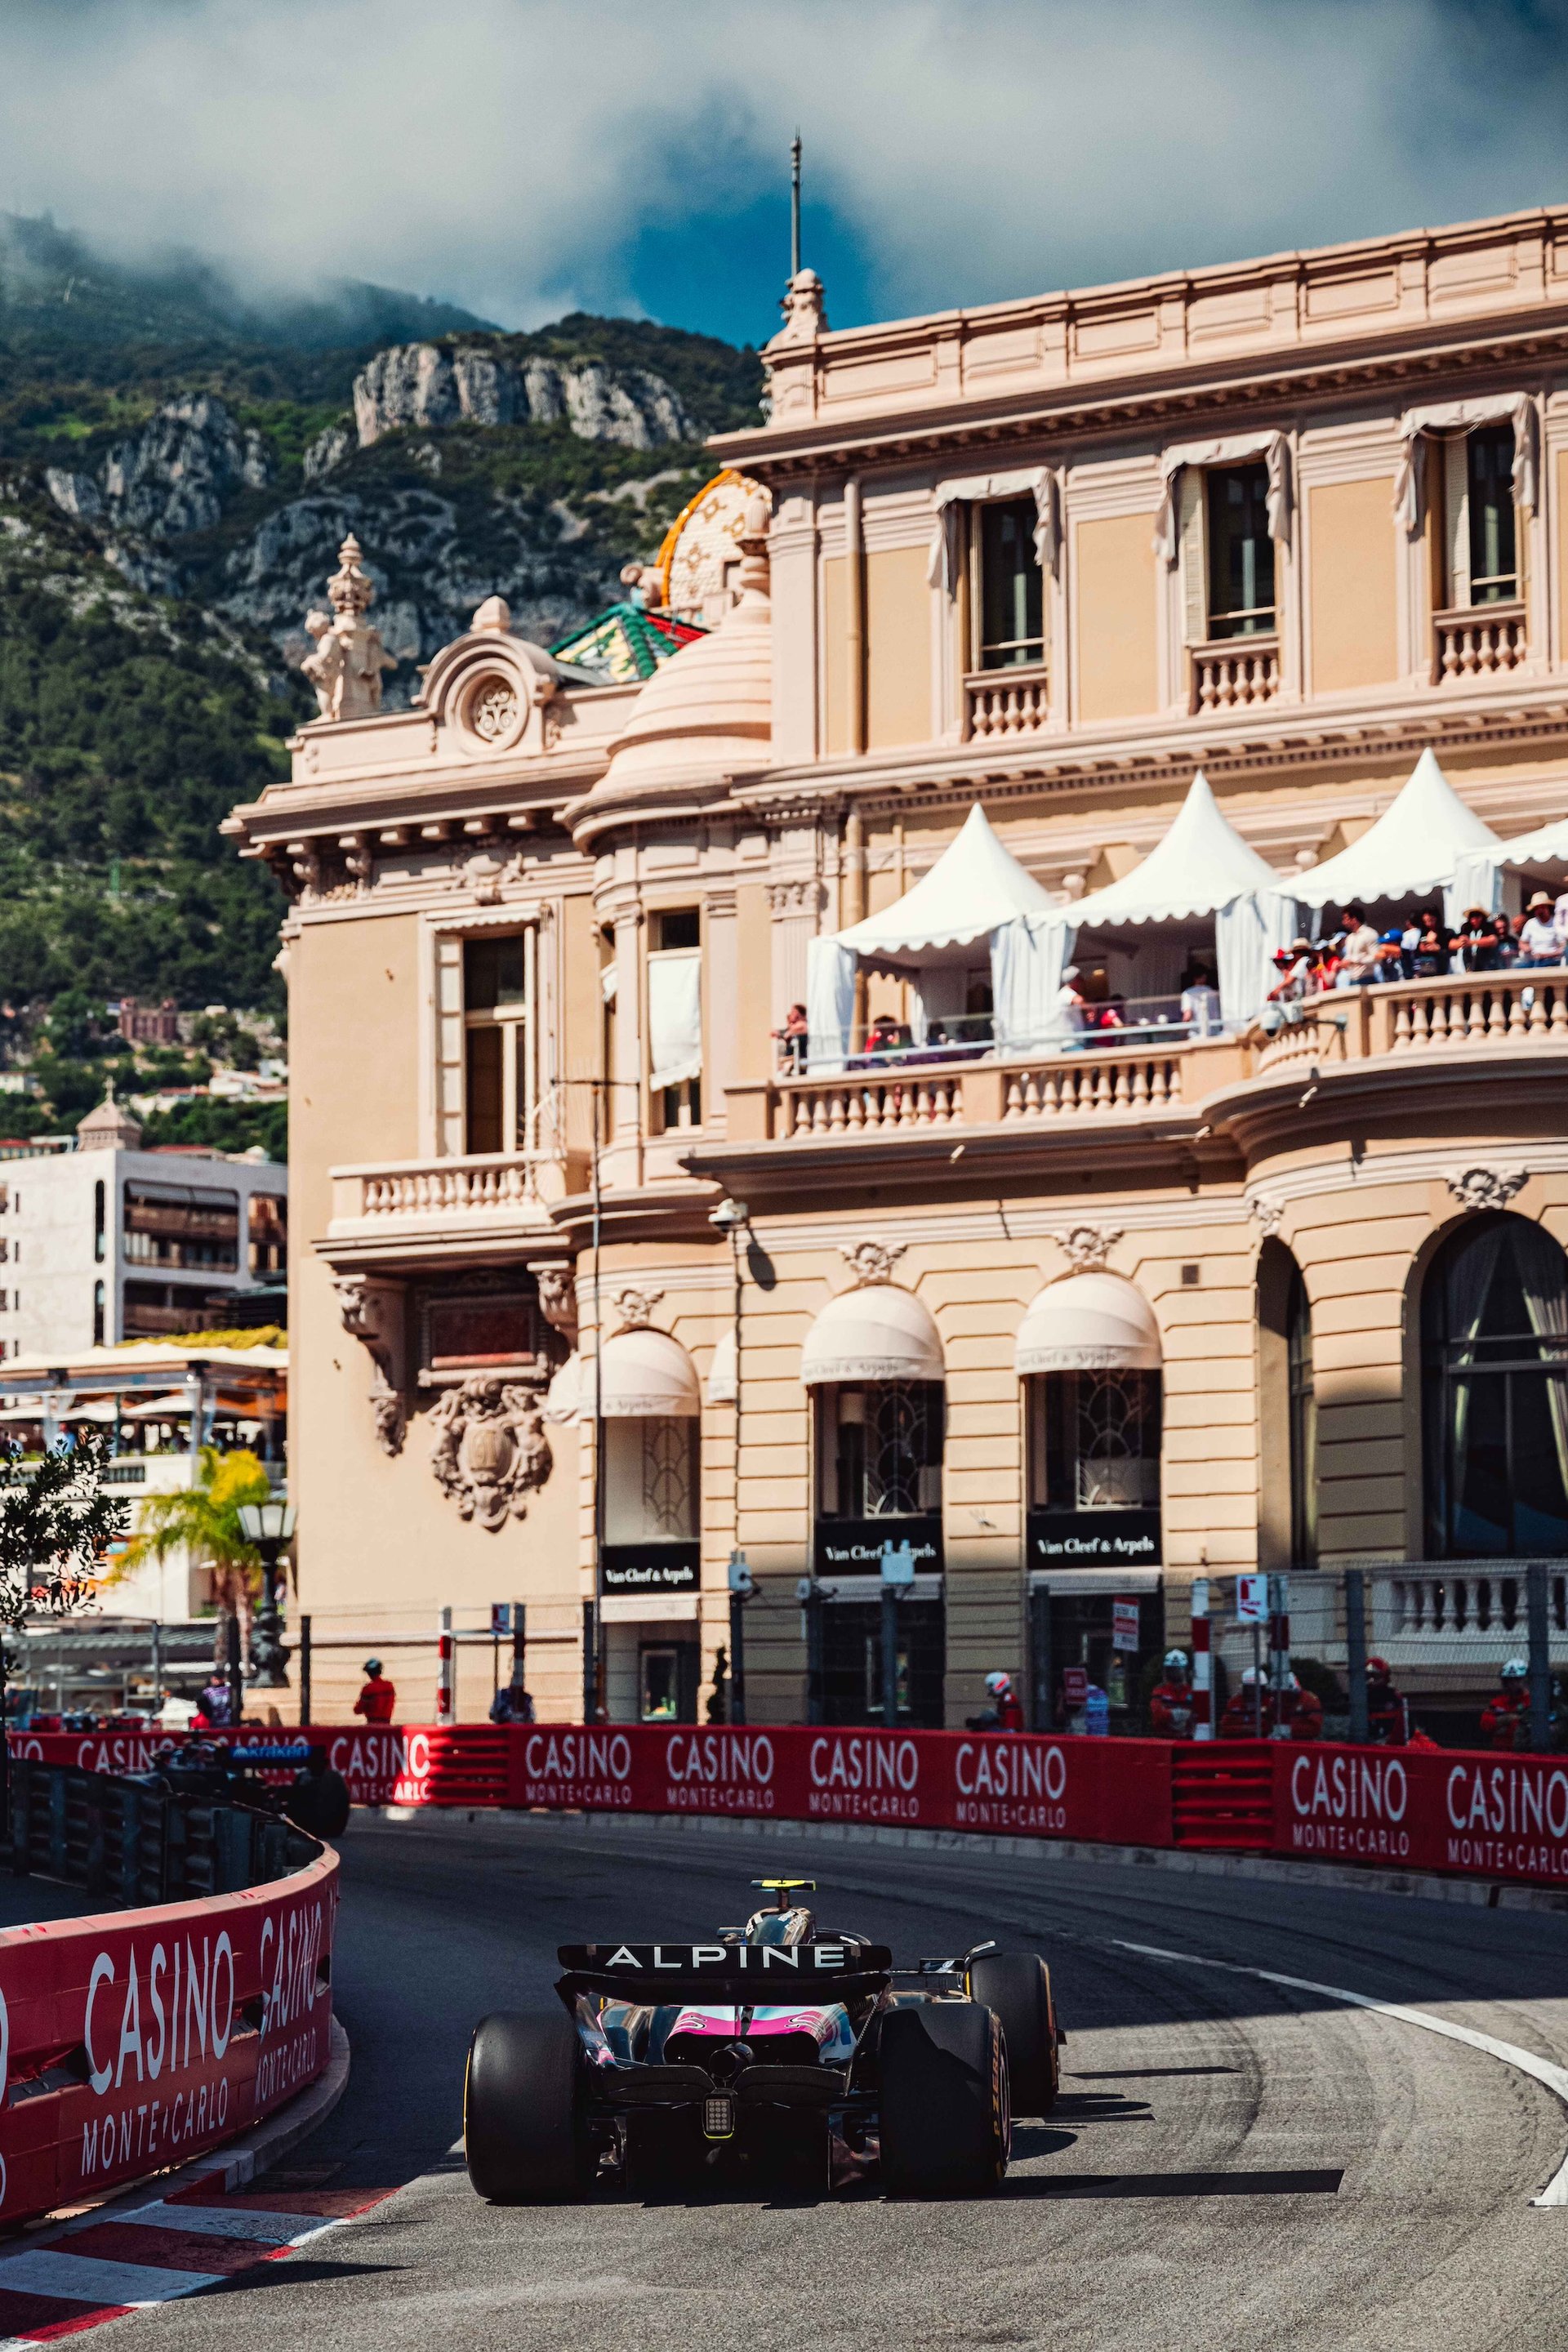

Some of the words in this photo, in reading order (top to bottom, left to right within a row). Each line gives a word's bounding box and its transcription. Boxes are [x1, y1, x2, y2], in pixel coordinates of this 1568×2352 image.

[825, 1546, 849, 1561] Van
[850, 1544, 884, 1561] Cleef
[1037, 1539, 1063, 1554] Van
[1064, 1537, 1101, 1554] Cleef
[1101, 1539, 1111, 1553] &
[1113, 1536, 1155, 1557] Arpels
[605, 1569, 625, 1584] Van
[626, 1567, 653, 1583] Cleef
[653, 1569, 662, 1582] &
[662, 1566, 694, 1584] Arpels
[331, 1734, 430, 1779] CASINO
[525, 1734, 631, 1780] CASINO
[666, 1735, 774, 1784] CASINO
[810, 1737, 919, 1791] CASINO
[956, 1743, 1066, 1800] CASINO
[351, 1782, 377, 1800] NTE
[1291, 1755, 1407, 1822] CASINO
[1446, 1765, 1568, 1838] CASINO
[260, 1900, 322, 2045] CASINO
[604, 1945, 846, 1968] ALPINE
[84, 1930, 234, 2096] CASINO
